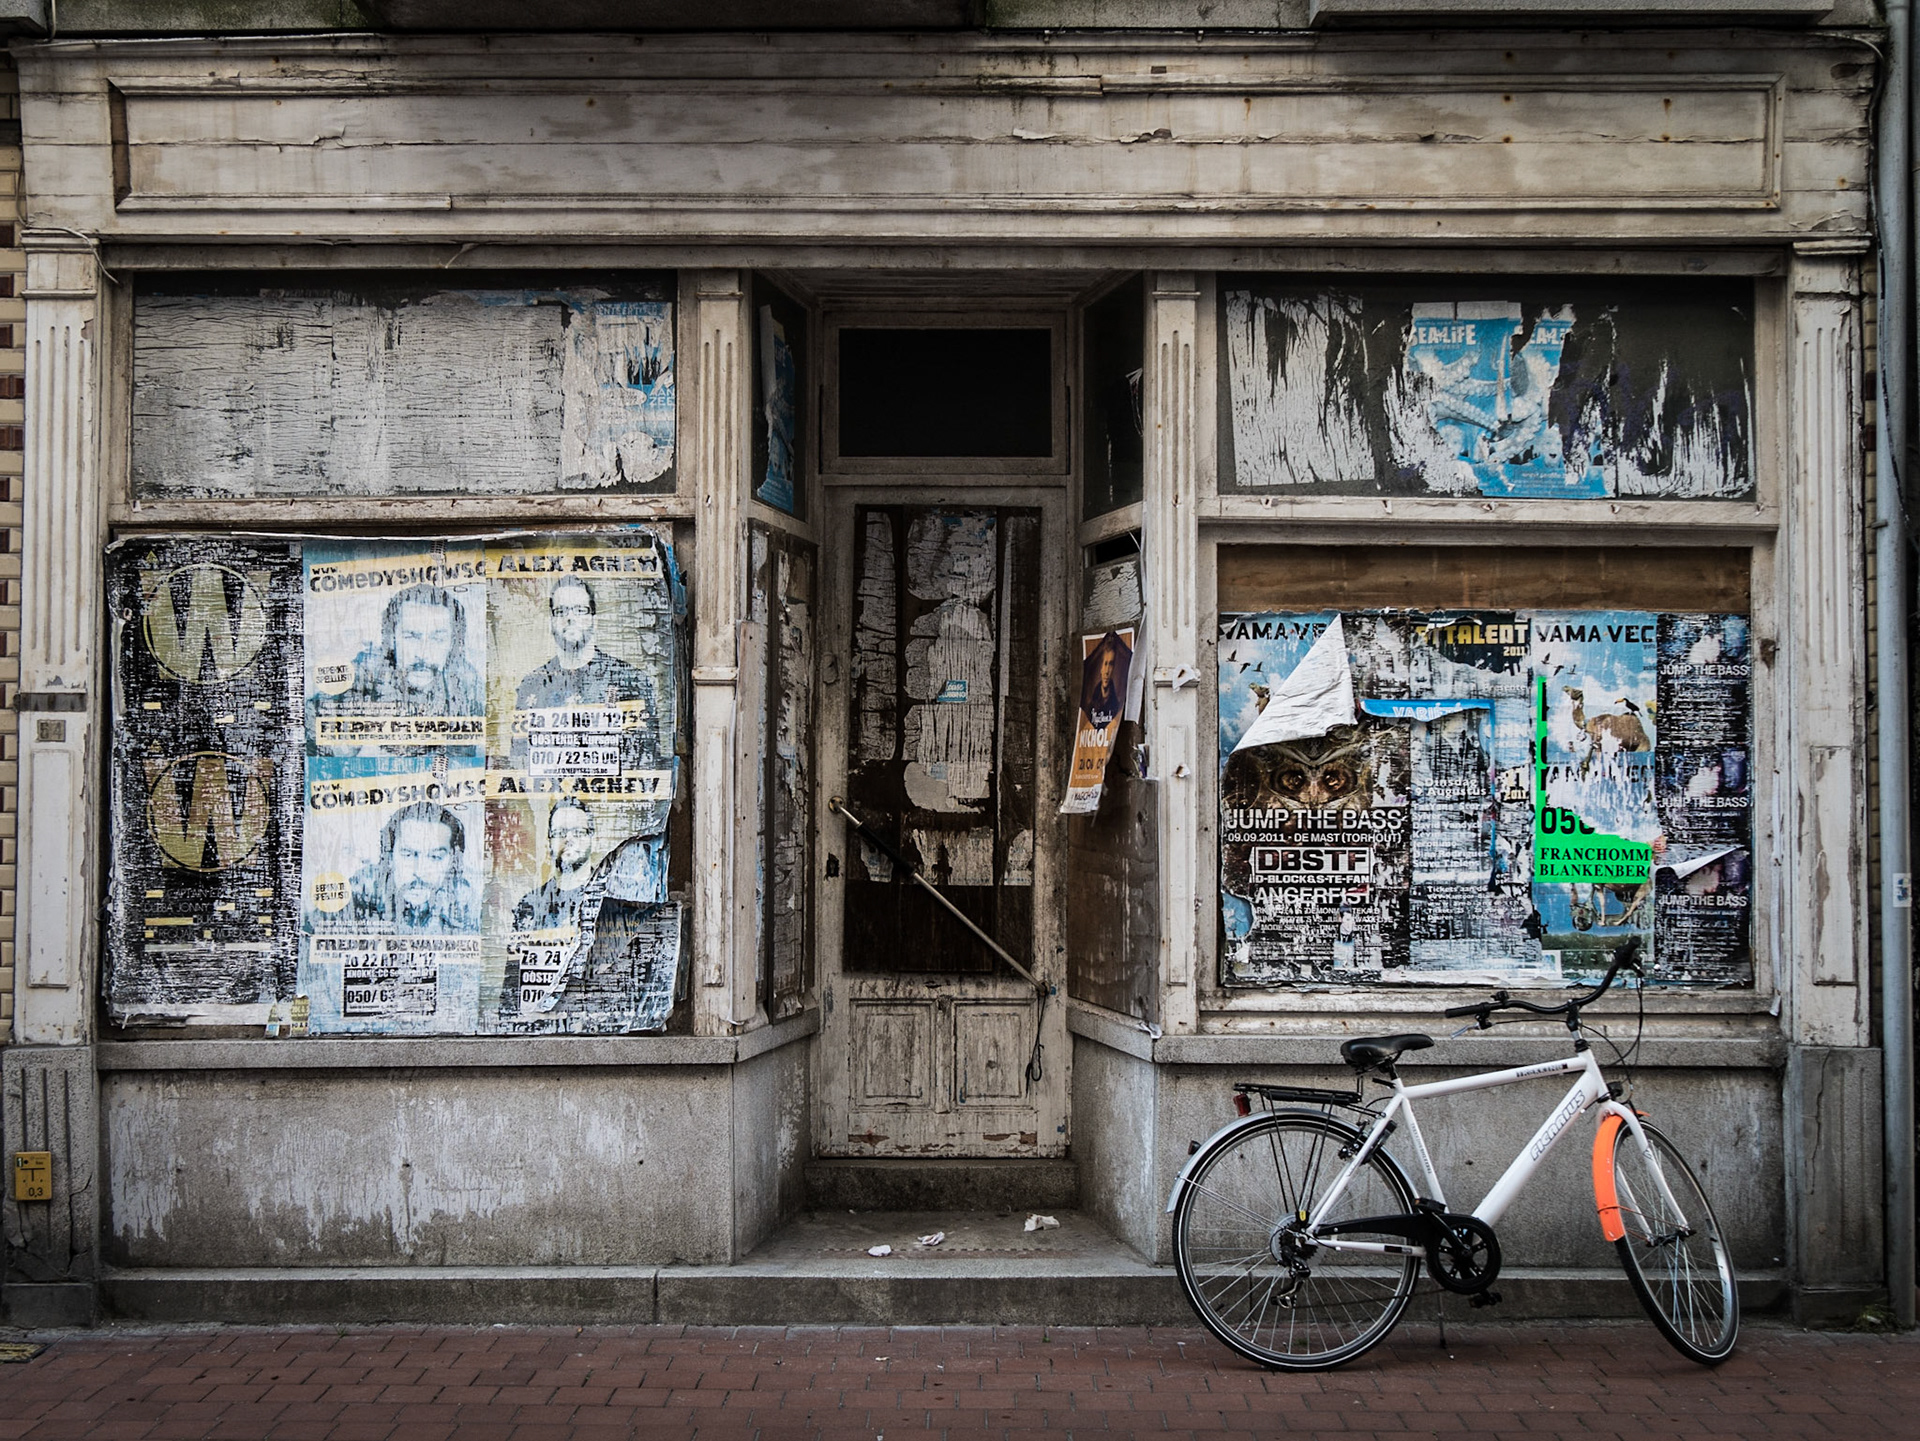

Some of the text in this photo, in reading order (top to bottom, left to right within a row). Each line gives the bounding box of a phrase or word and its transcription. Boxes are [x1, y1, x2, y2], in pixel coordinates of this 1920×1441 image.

[498, 555, 658, 573] ALEX AGNEW
[1503, 646, 1526, 656] 2011
[1660, 664, 1748, 677] JUMP THE BASS
[552, 712, 568, 728] 24
[572, 712, 600, 728] NOV
[532, 752, 554, 765] 070
[556, 751, 562, 765] /
[565, 752, 580, 765] 22
[498, 777, 660, 794] ALEX AGNEW
[1425, 778, 1478, 789] Dinsdag
[1416, 787, 1487, 799] 9 Augustus
[1505, 790, 1527, 800] 2011
[1660, 797, 1747, 808] JUMP THE BASS
[1226, 808, 1402, 830] JUMP THE BASS
[1227, 833, 1286, 843] 09.09.2011
[1294, 833, 1309, 843] DE
[1311, 833, 1340, 843] MAST
[1341, 833, 1402, 844] (TORHOUT)
[1258, 849, 1368, 872] DBSTF
[1540, 847, 1650, 862] FRANCHOMM
[1254, 886, 1375, 905] ANGERFIST
[1658, 895, 1748, 907] JUMP THE BASS
[362, 952, 378, 967] 22
[544, 950, 561, 966] 24
